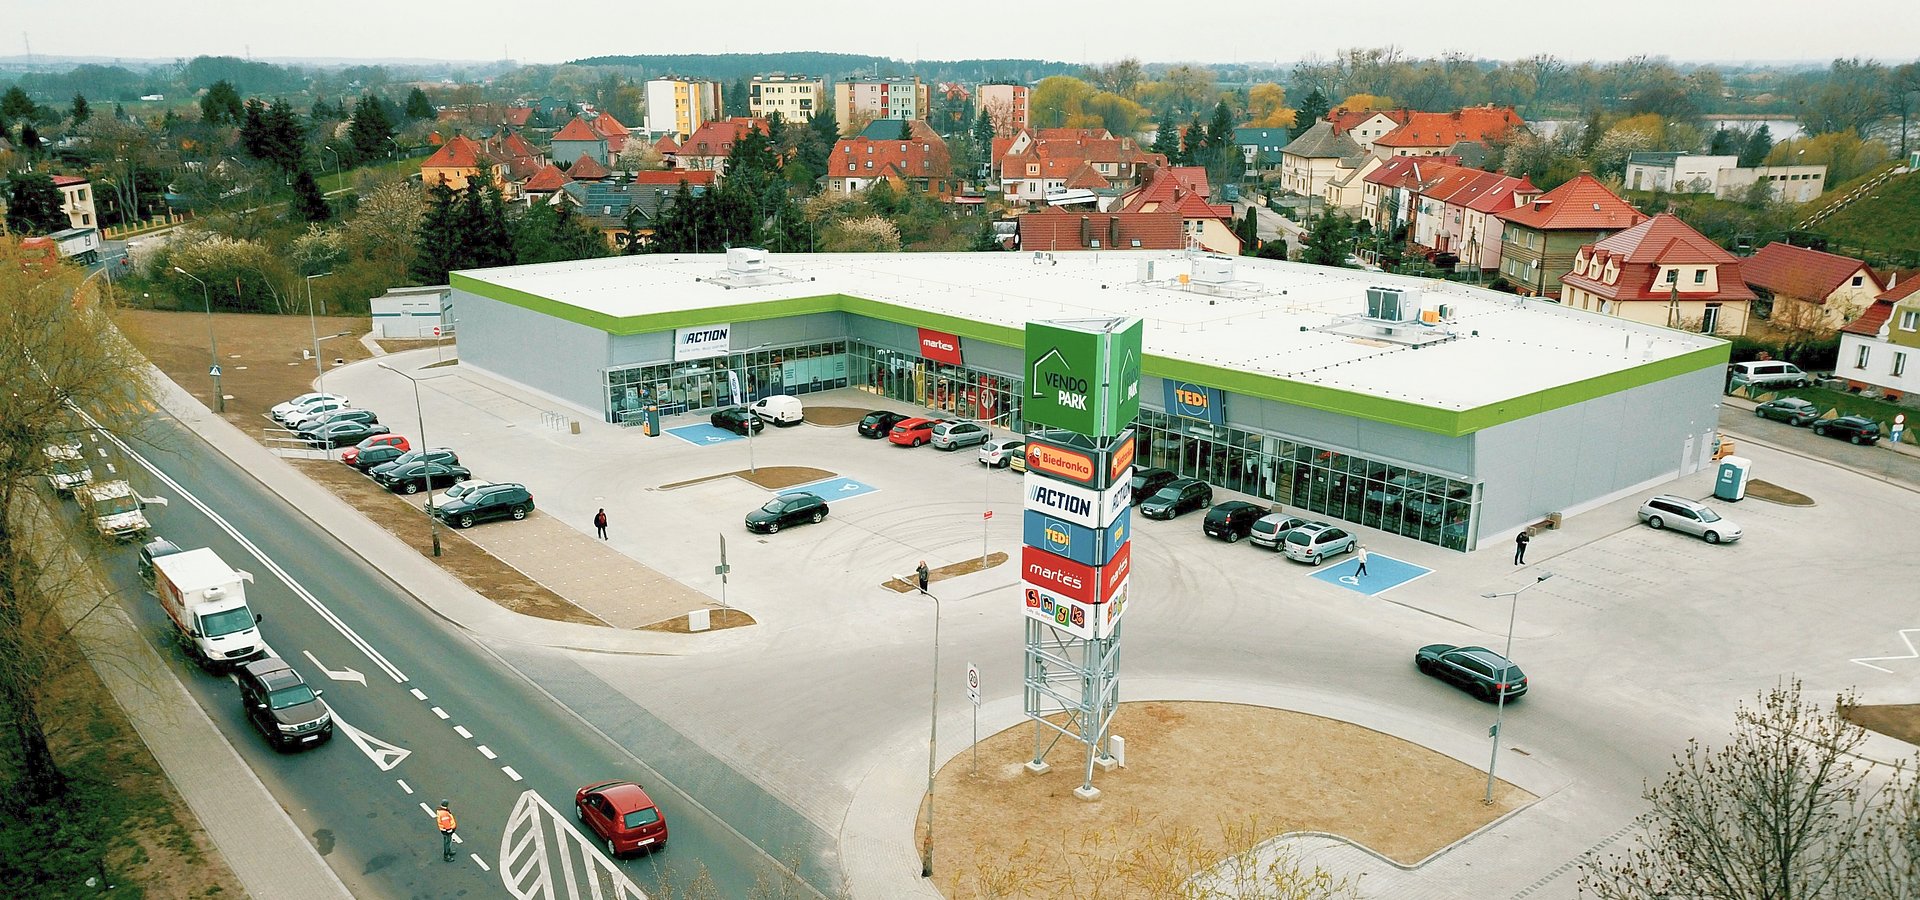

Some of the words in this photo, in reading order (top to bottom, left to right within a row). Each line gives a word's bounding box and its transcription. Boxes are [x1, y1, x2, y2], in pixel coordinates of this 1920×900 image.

[685, 329, 728, 344] ACTION
[923, 338, 954, 351] martes
[1044, 371, 1088, 394] VENDO
[1058, 390, 1087, 411] PARK
[1176, 389, 1207, 408] TEDi
[1042, 452, 1089, 475] Biedronka
[1035, 486, 1091, 518] ACTION
[1045, 528, 1069, 546] TEDi
[1029, 562, 1082, 590] martes
